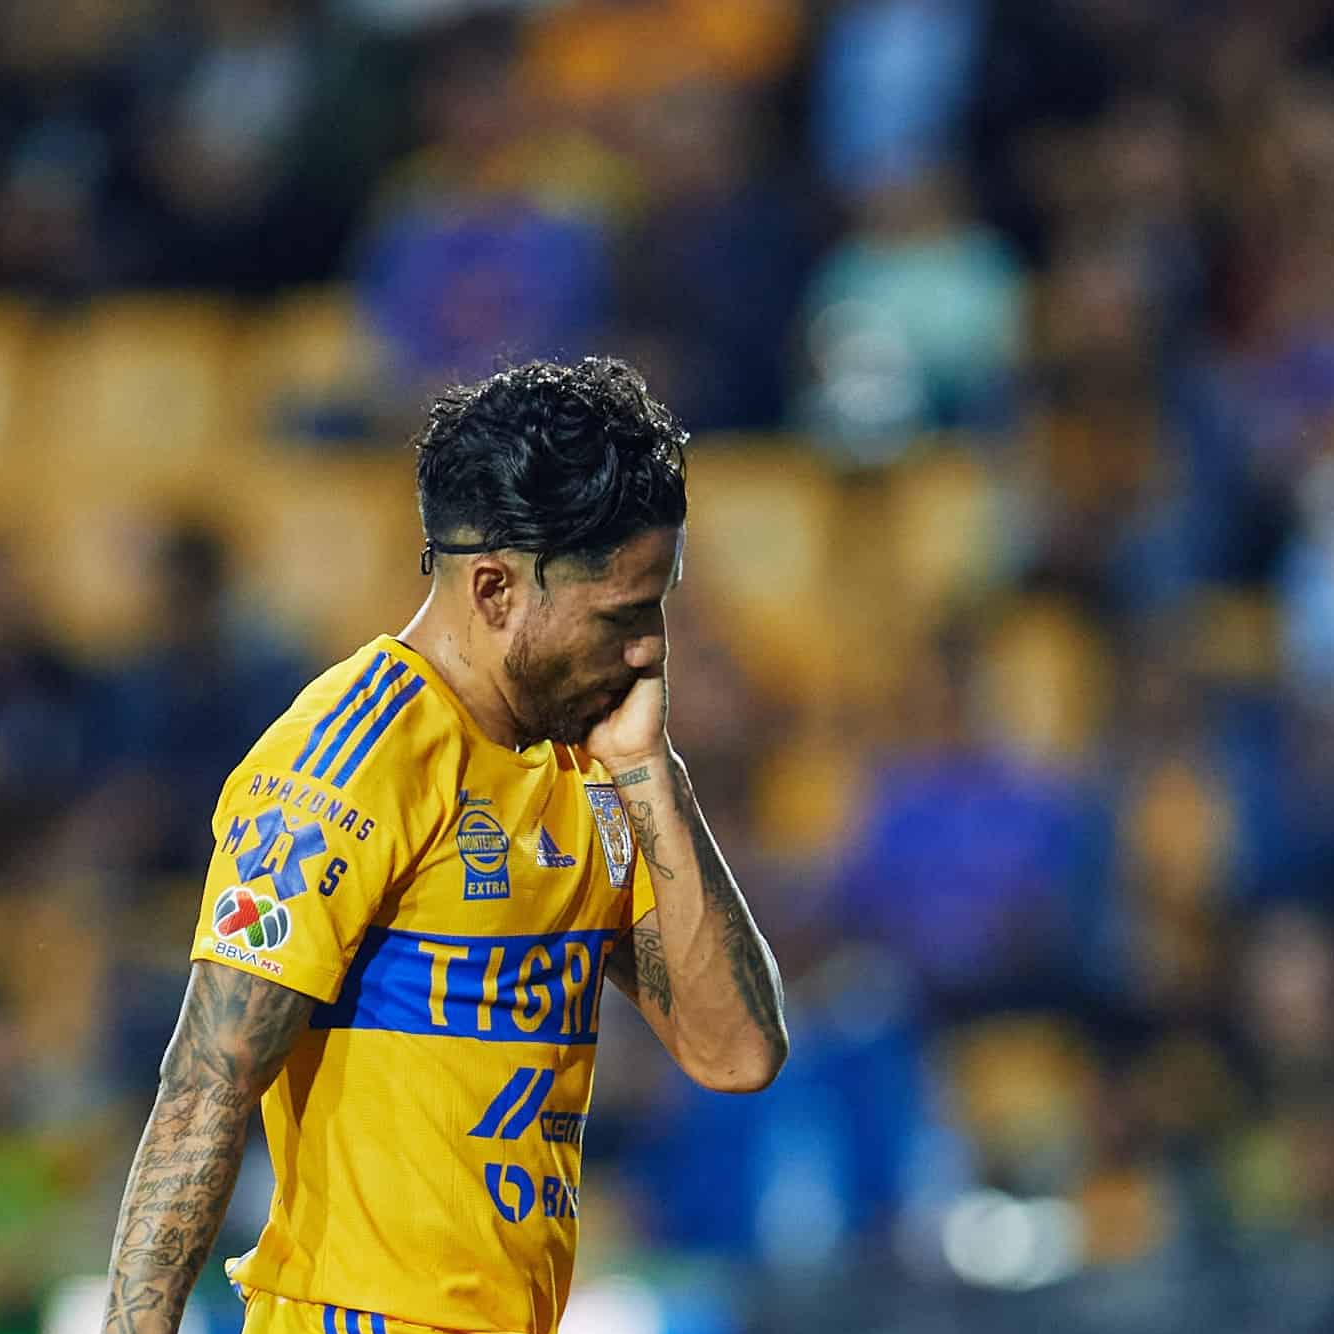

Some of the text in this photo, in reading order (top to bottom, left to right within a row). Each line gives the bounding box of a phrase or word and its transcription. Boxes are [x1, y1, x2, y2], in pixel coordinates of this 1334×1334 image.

[249, 774, 375, 841] AMAZONAS
[468, 881, 508, 896] EXTRA
[215, 942, 281, 975] BBVA MX
